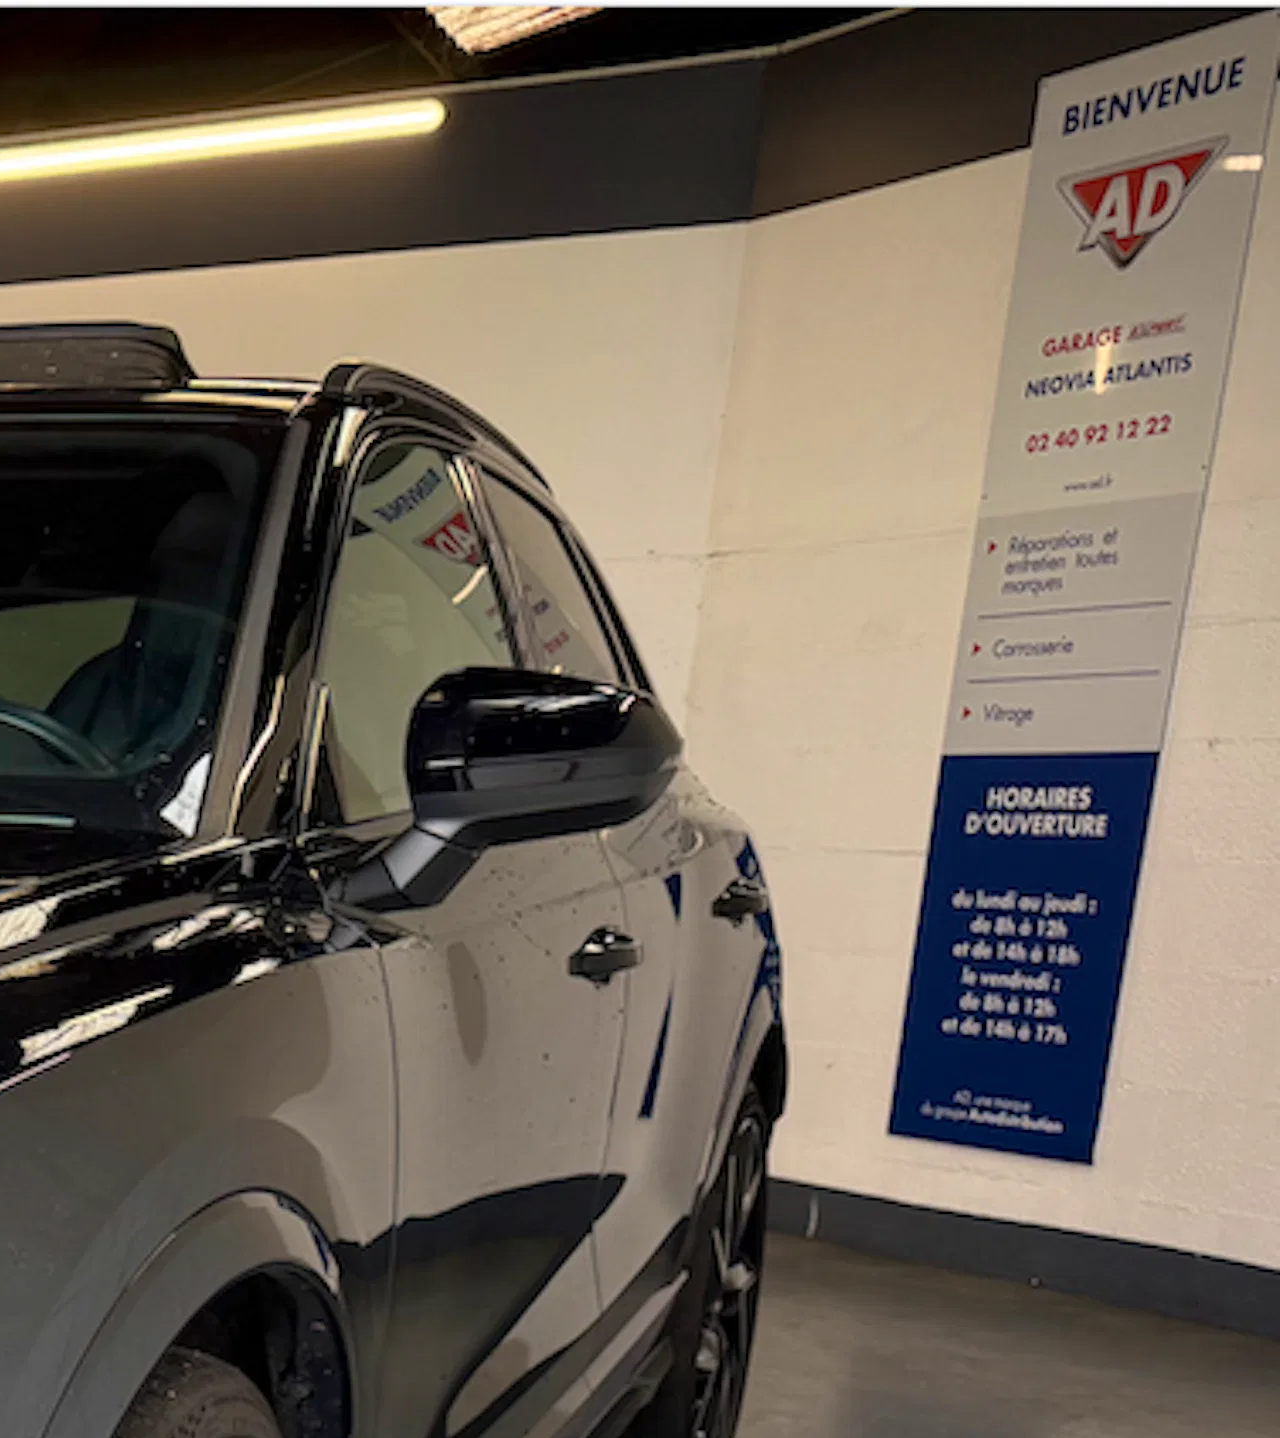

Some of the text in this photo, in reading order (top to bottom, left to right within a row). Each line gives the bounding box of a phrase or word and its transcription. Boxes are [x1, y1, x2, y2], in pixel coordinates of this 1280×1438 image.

[1062, 56, 1246, 136] BIENVENUE
[1077, 162, 1187, 251] AD
[1042, 326, 1122, 357] GARAGE
[1025, 353, 1192, 398] NEOVIA ATLANTIS
[1026, 414, 1172, 453] 02 40 92 12 22
[1103, 527, 1118, 545] et
[986, 786, 1092, 811] HORAIRES
[964, 810, 1109, 838] D'OUVERTURE
